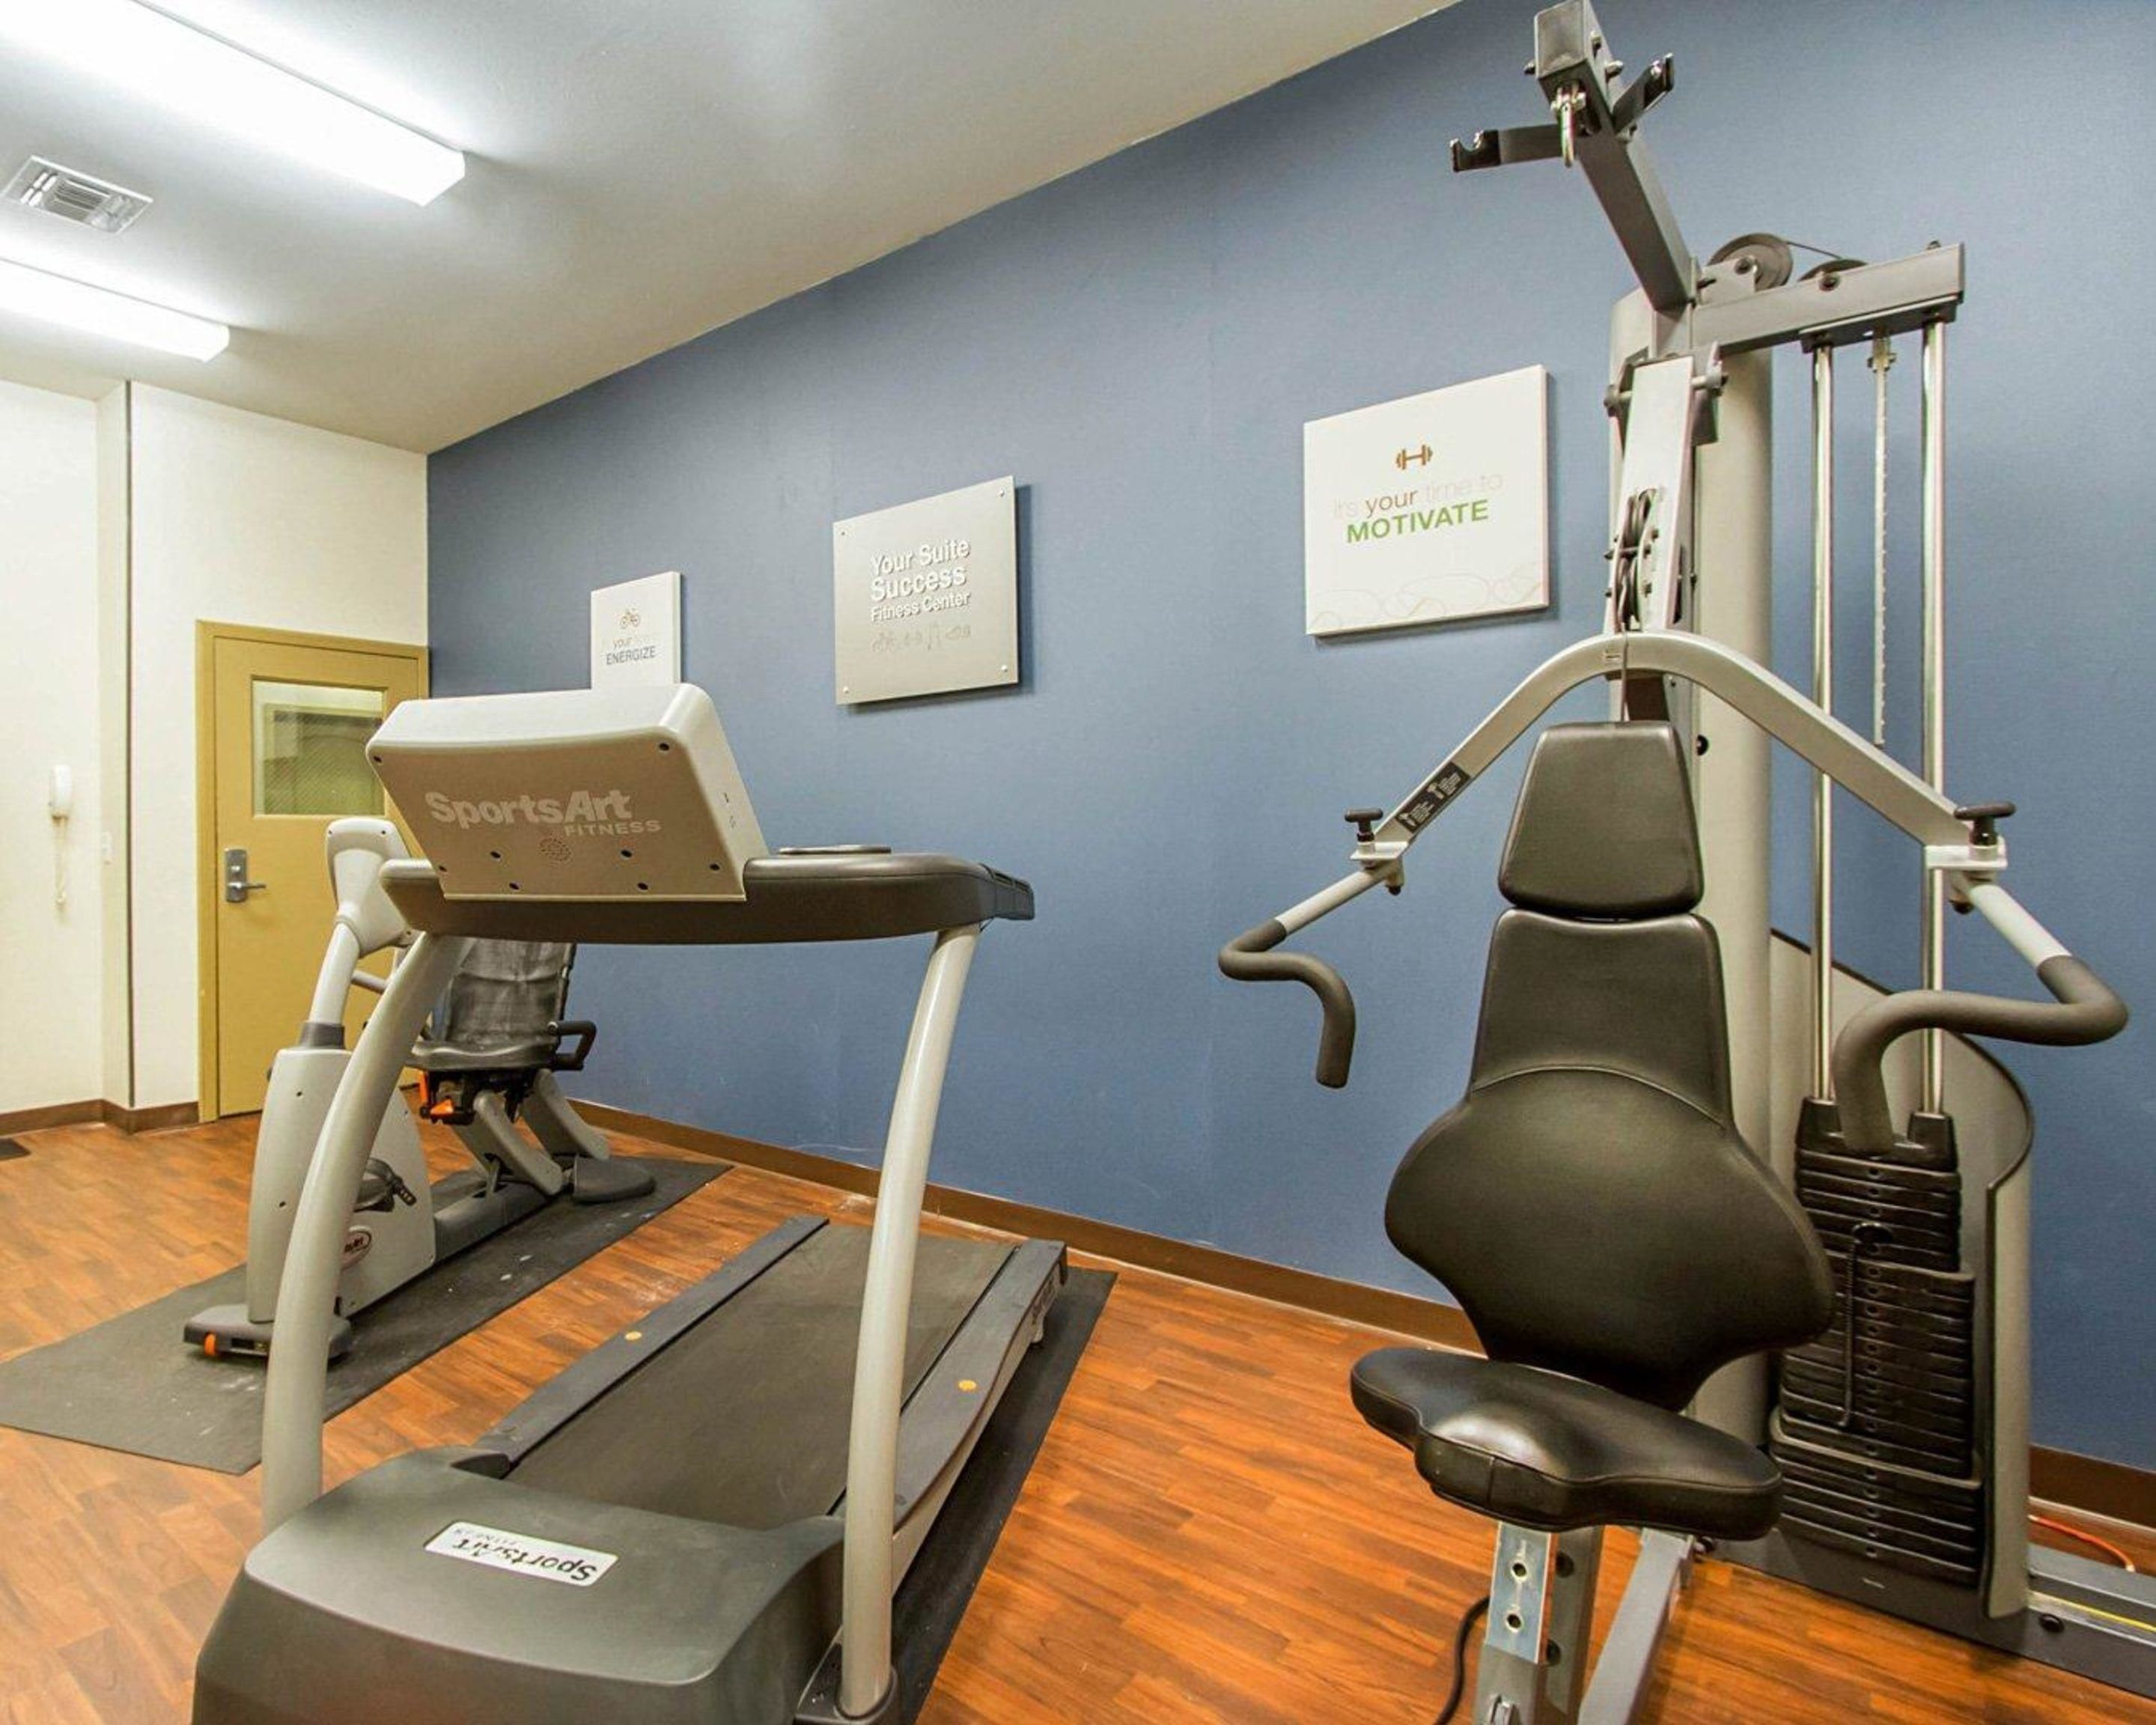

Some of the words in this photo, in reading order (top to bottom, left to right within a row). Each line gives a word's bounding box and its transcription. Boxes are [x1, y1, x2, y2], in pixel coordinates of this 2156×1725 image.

[1366, 490, 1418, 518] your
[1347, 499, 1488, 544] MOTIVATE
[872, 553, 913, 576] Your
[920, 539, 970, 565] Suite
[870, 566, 968, 602] Success
[871, 603, 920, 622] Fitness
[923, 592, 971, 612] Center
[606, 645, 657, 666] ENERGIZE
[424, 790, 634, 829] SportsArt
[564, 820, 662, 837] FITNESS
